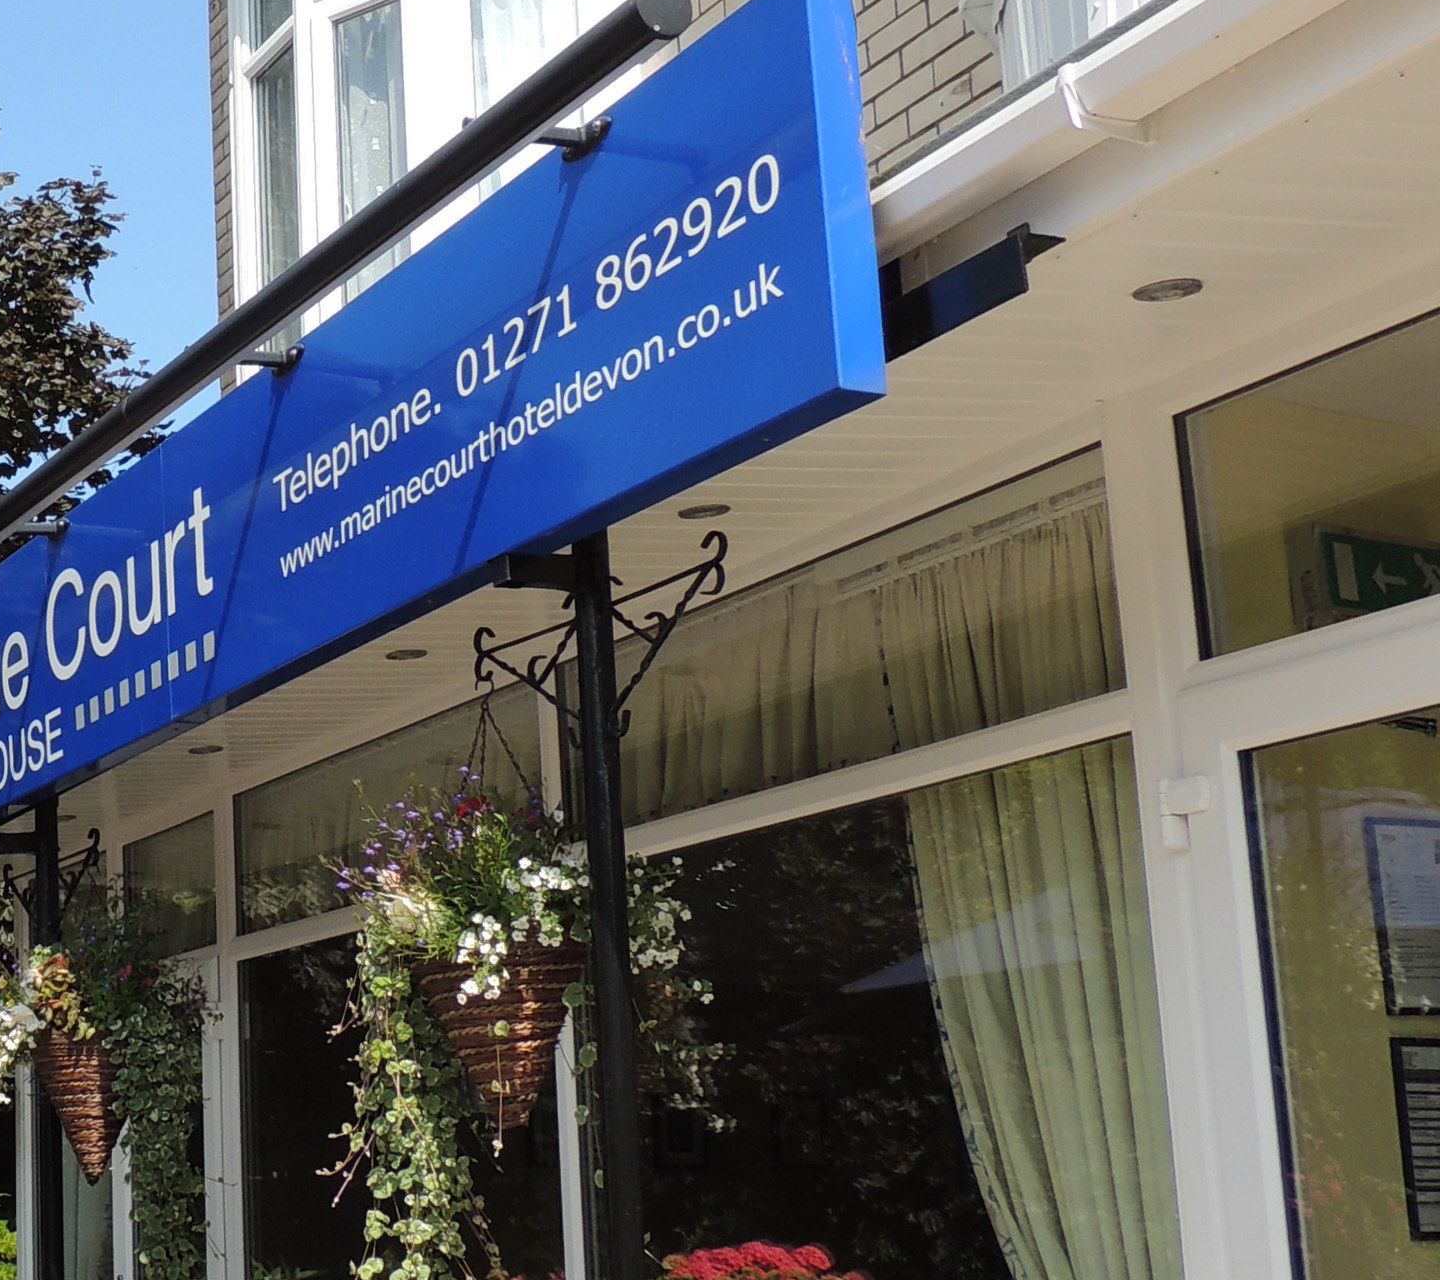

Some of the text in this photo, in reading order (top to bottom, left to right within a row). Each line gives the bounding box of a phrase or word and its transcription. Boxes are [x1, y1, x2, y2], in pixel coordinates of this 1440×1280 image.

[272, 154, 780, 512] Telephone. 01271 862920
[280, 262, 784, 578] www.marinecourthoteldevon.co.uk
[45, 486, 214, 681] Court
